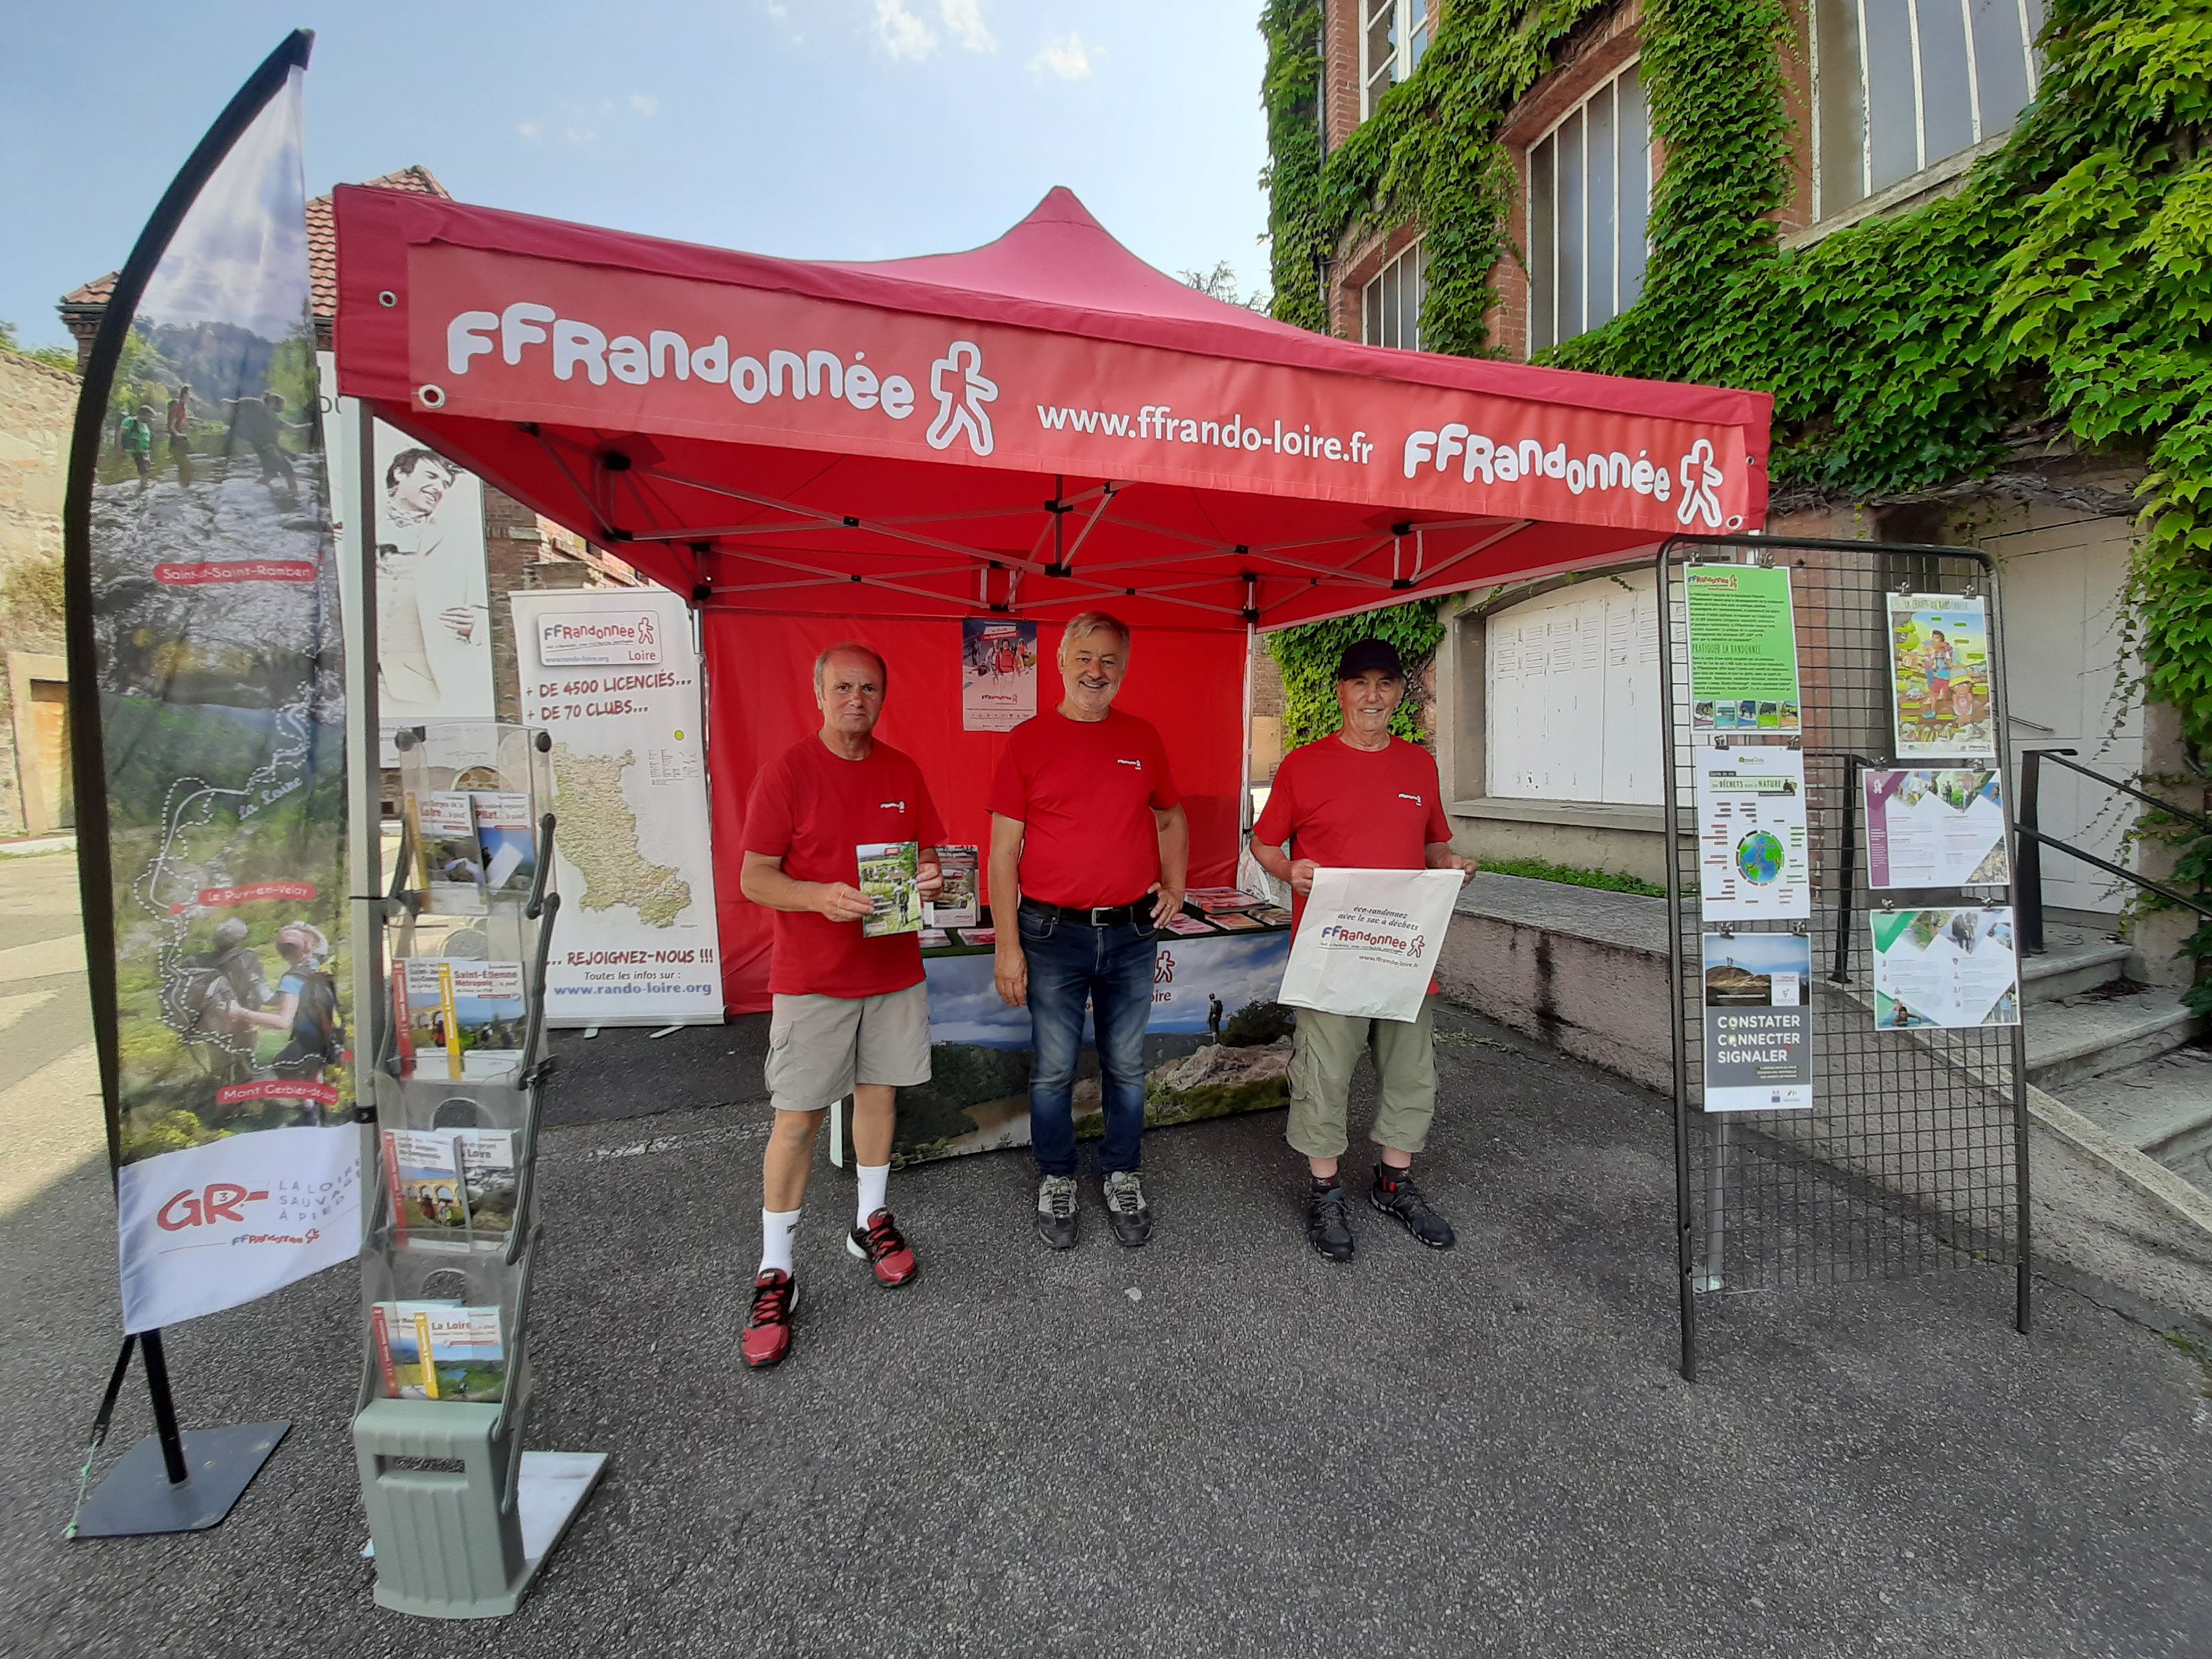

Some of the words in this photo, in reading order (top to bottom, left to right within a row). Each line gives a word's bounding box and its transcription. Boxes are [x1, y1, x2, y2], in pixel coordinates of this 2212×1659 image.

[1036, 404, 1374, 465] www.ffrando-loire.fr
[628, 650, 656, 661] Loire
[540, 684, 558, 698] DE
[563, 680, 598, 695] 4500
[604, 669, 692, 692] LICENCIÉS...
[541, 706, 560, 720] DE
[564, 705, 581, 720] 70
[586, 700, 648, 717] CLUBS...
[1357, 914, 1363, 922] le
[567, 950, 694, 965] REJOIGNEZ-NOUS
[700, 949, 714, 964] !!!
[453, 969, 518, 978] Saint-Étienne
[584, 970, 614, 980] Toutes
[618, 971, 630, 980] les
[633, 970, 656, 980] infos
[554, 982, 712, 995] www.rando-loire.org
[1717, 1015, 1800, 1029] CONSTATER
[1717, 1050, 1787, 1063] SIGNALER
[224, 1087, 260, 1099] Mont
[279, 1180, 299, 1192] LA
[431, 1322, 443, 1330] La
